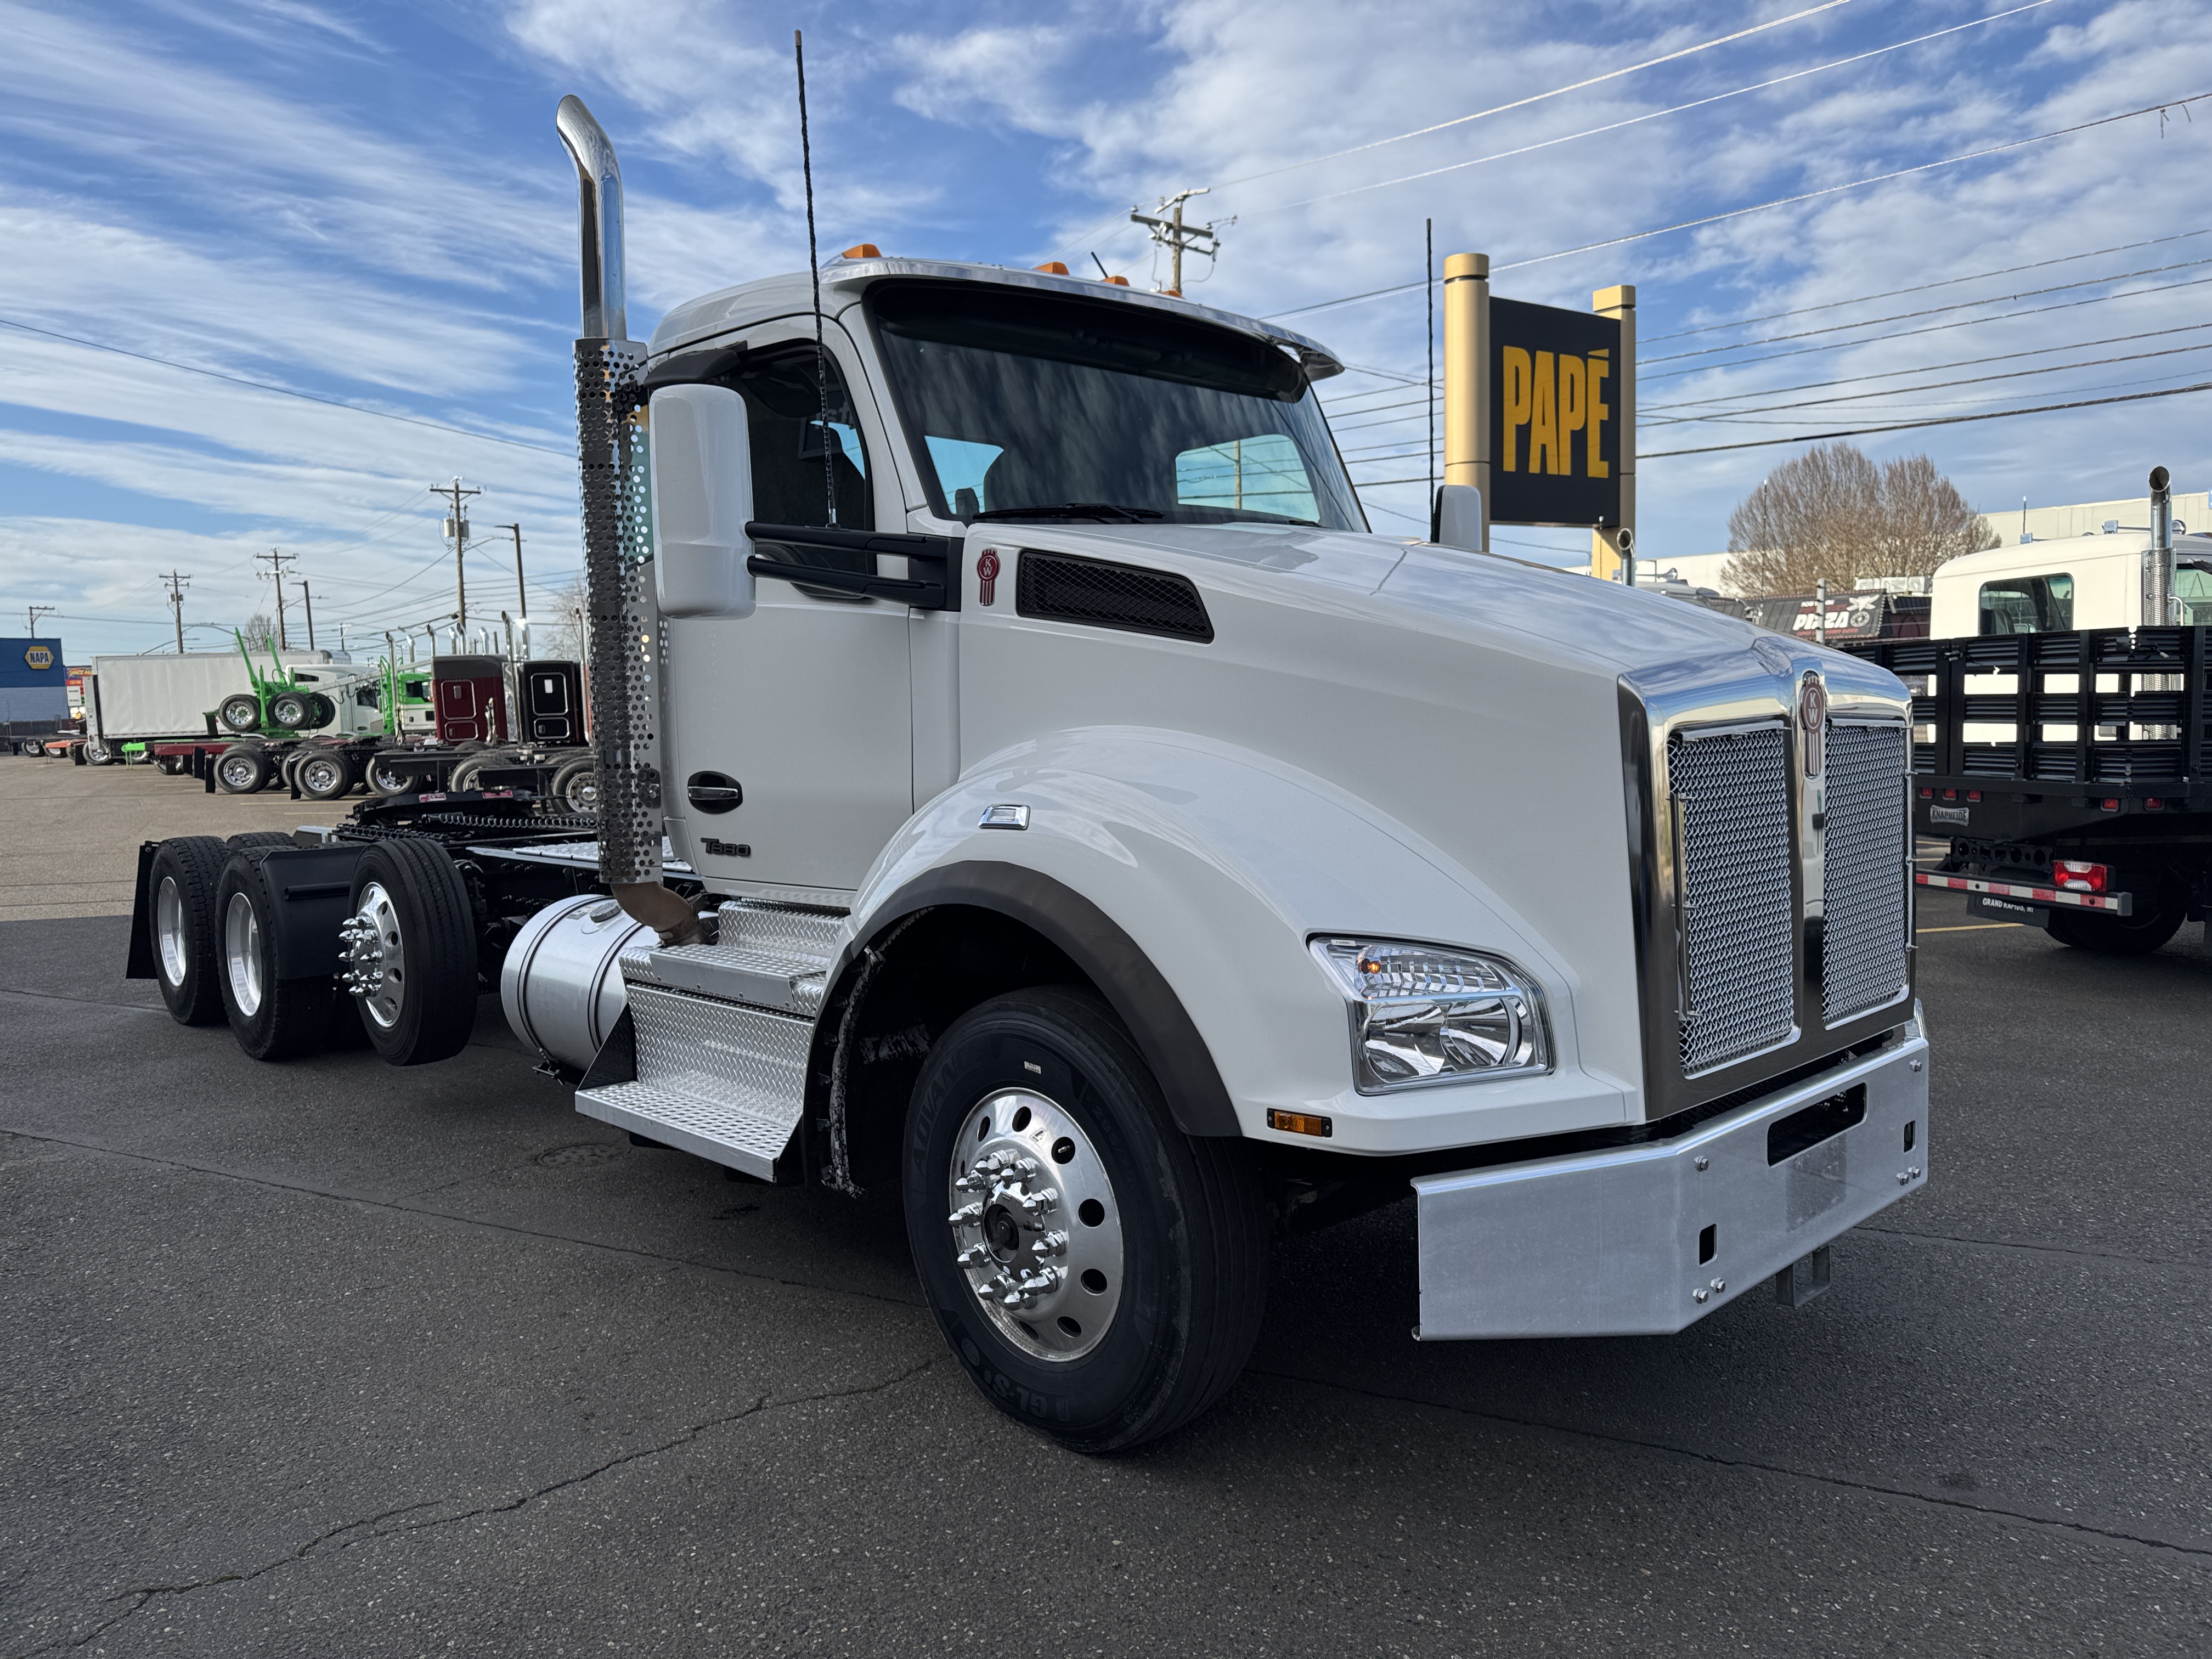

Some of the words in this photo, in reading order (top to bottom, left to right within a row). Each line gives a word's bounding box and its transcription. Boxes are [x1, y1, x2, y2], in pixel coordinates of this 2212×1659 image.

[1503, 346, 1610, 478] PAPÉ
[30, 652, 49, 663] NAPA
[1932, 809, 1967, 822] KNAPHEIDE
[700, 837, 751, 857] T880
[1982, 897, 2003, 908] GRAND
